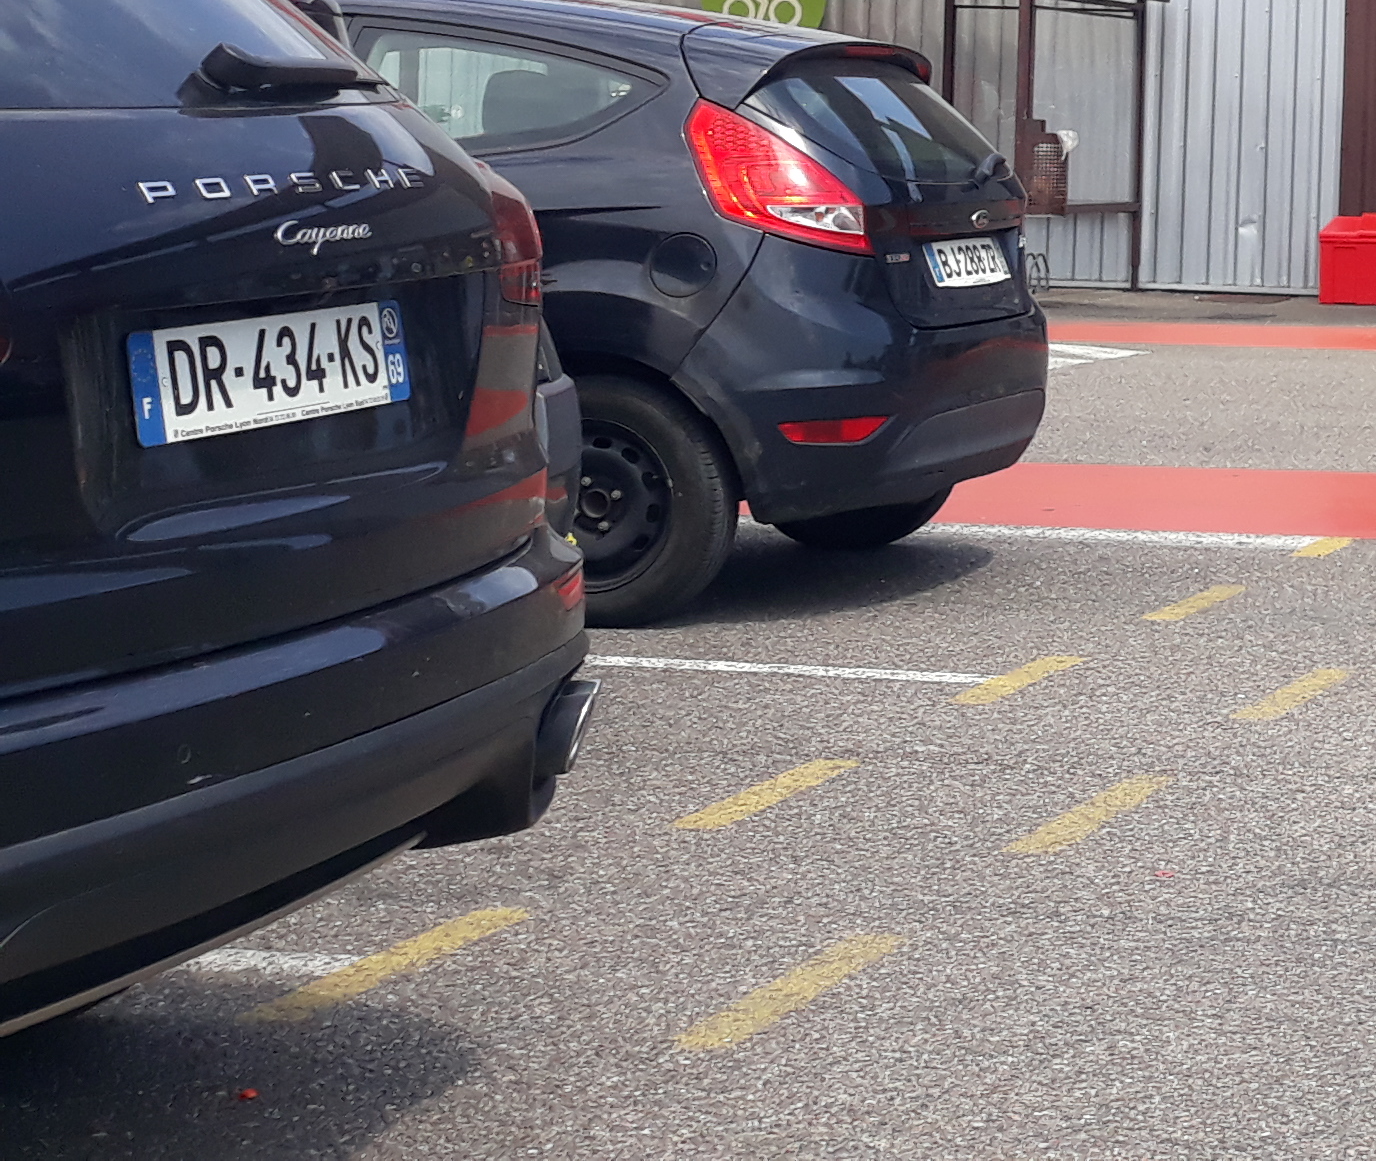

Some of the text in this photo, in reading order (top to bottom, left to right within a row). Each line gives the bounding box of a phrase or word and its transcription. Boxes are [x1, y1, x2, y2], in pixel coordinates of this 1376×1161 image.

[136, 168, 426, 205] PORSCHE
[274, 220, 373, 255] Cayenne
[165, 315, 381, 418] DR-434-KS
[388, 353, 404, 385] 69
[142, 397, 153, 421] F
